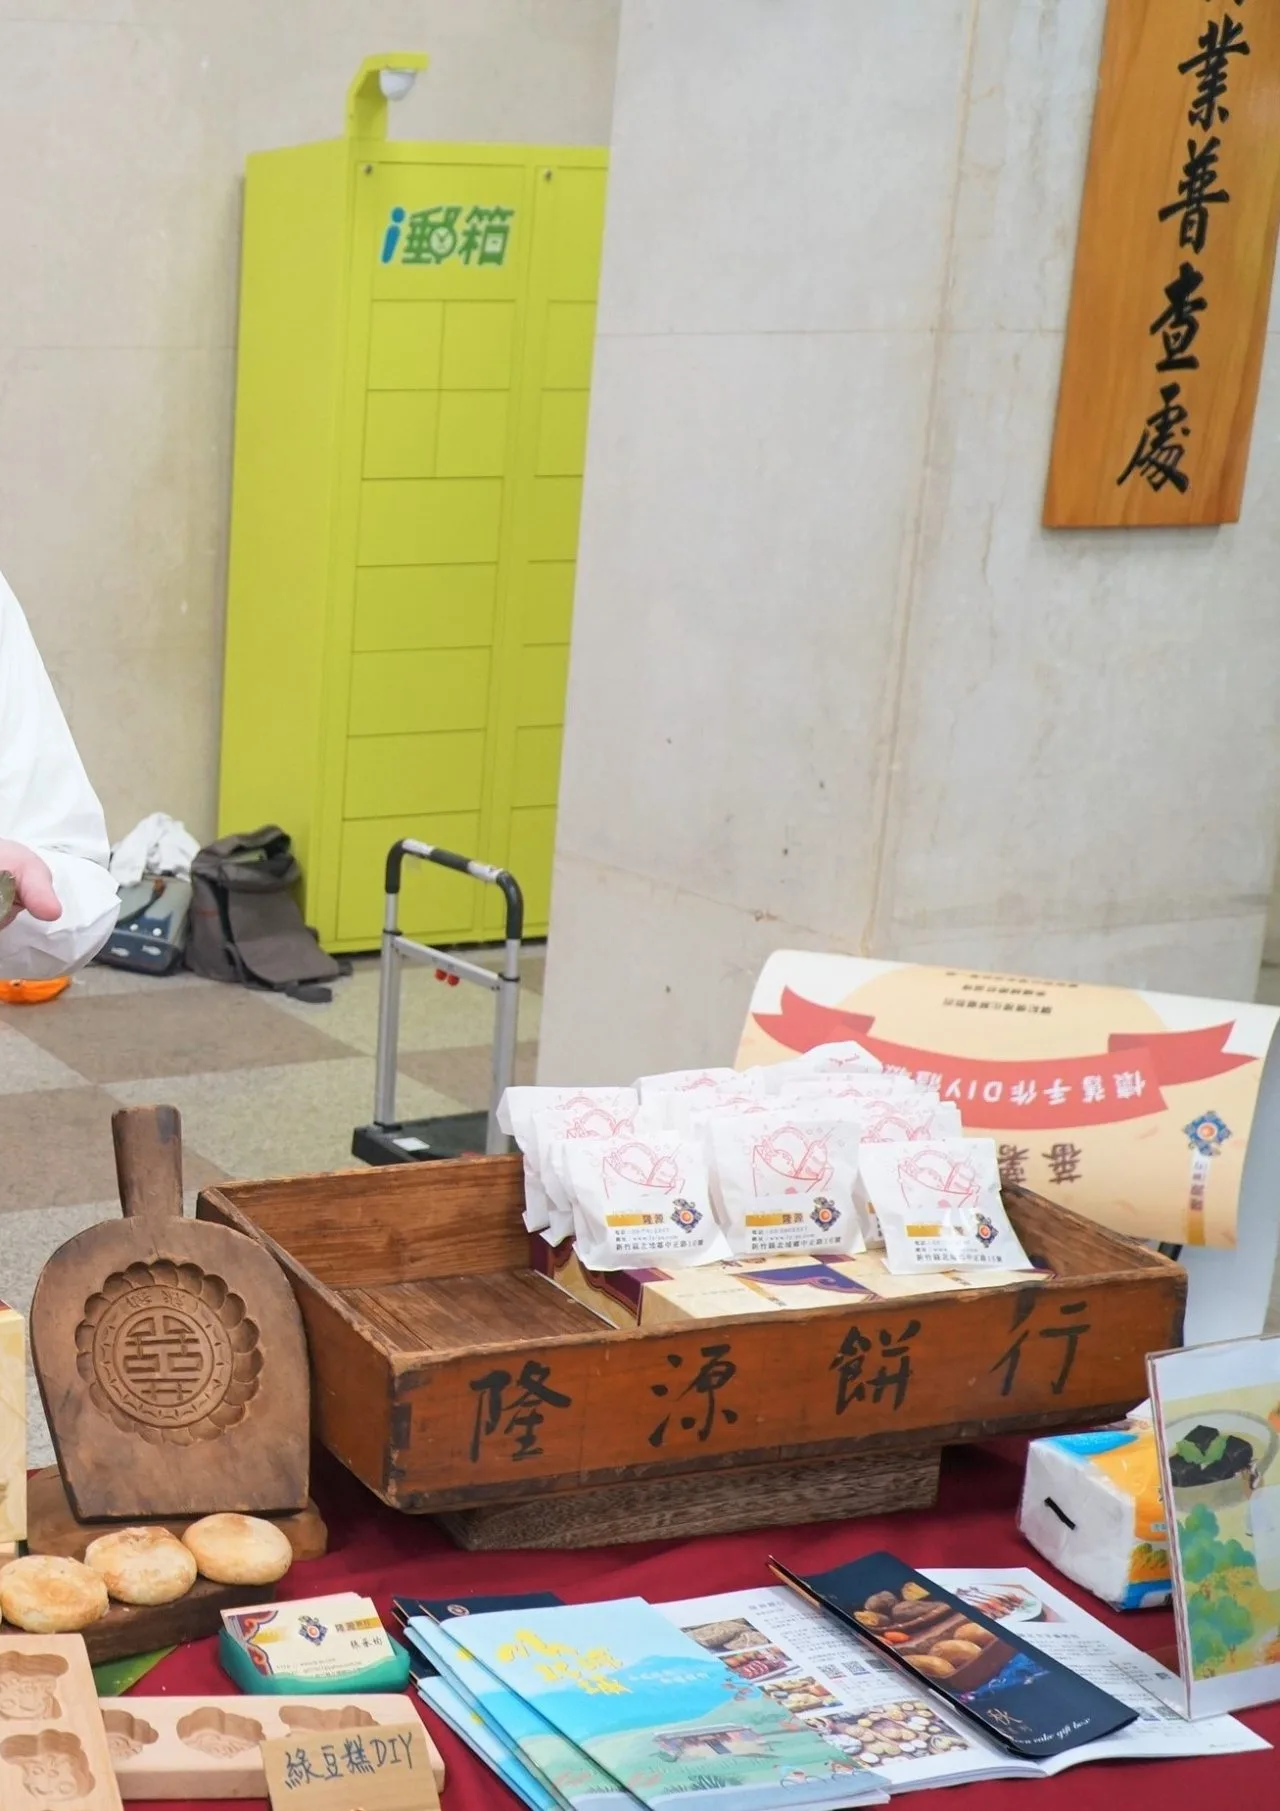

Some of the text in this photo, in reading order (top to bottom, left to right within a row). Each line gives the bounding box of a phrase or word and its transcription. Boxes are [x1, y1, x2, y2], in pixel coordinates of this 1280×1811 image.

[381, 206, 515, 265] i郵箱
[1117, 0, 1250, 493] 業普查處
[470, 1286, 1091, 1462] 隆源餅行
[284, 1731, 414, 1790] 綠豆糕DIY
